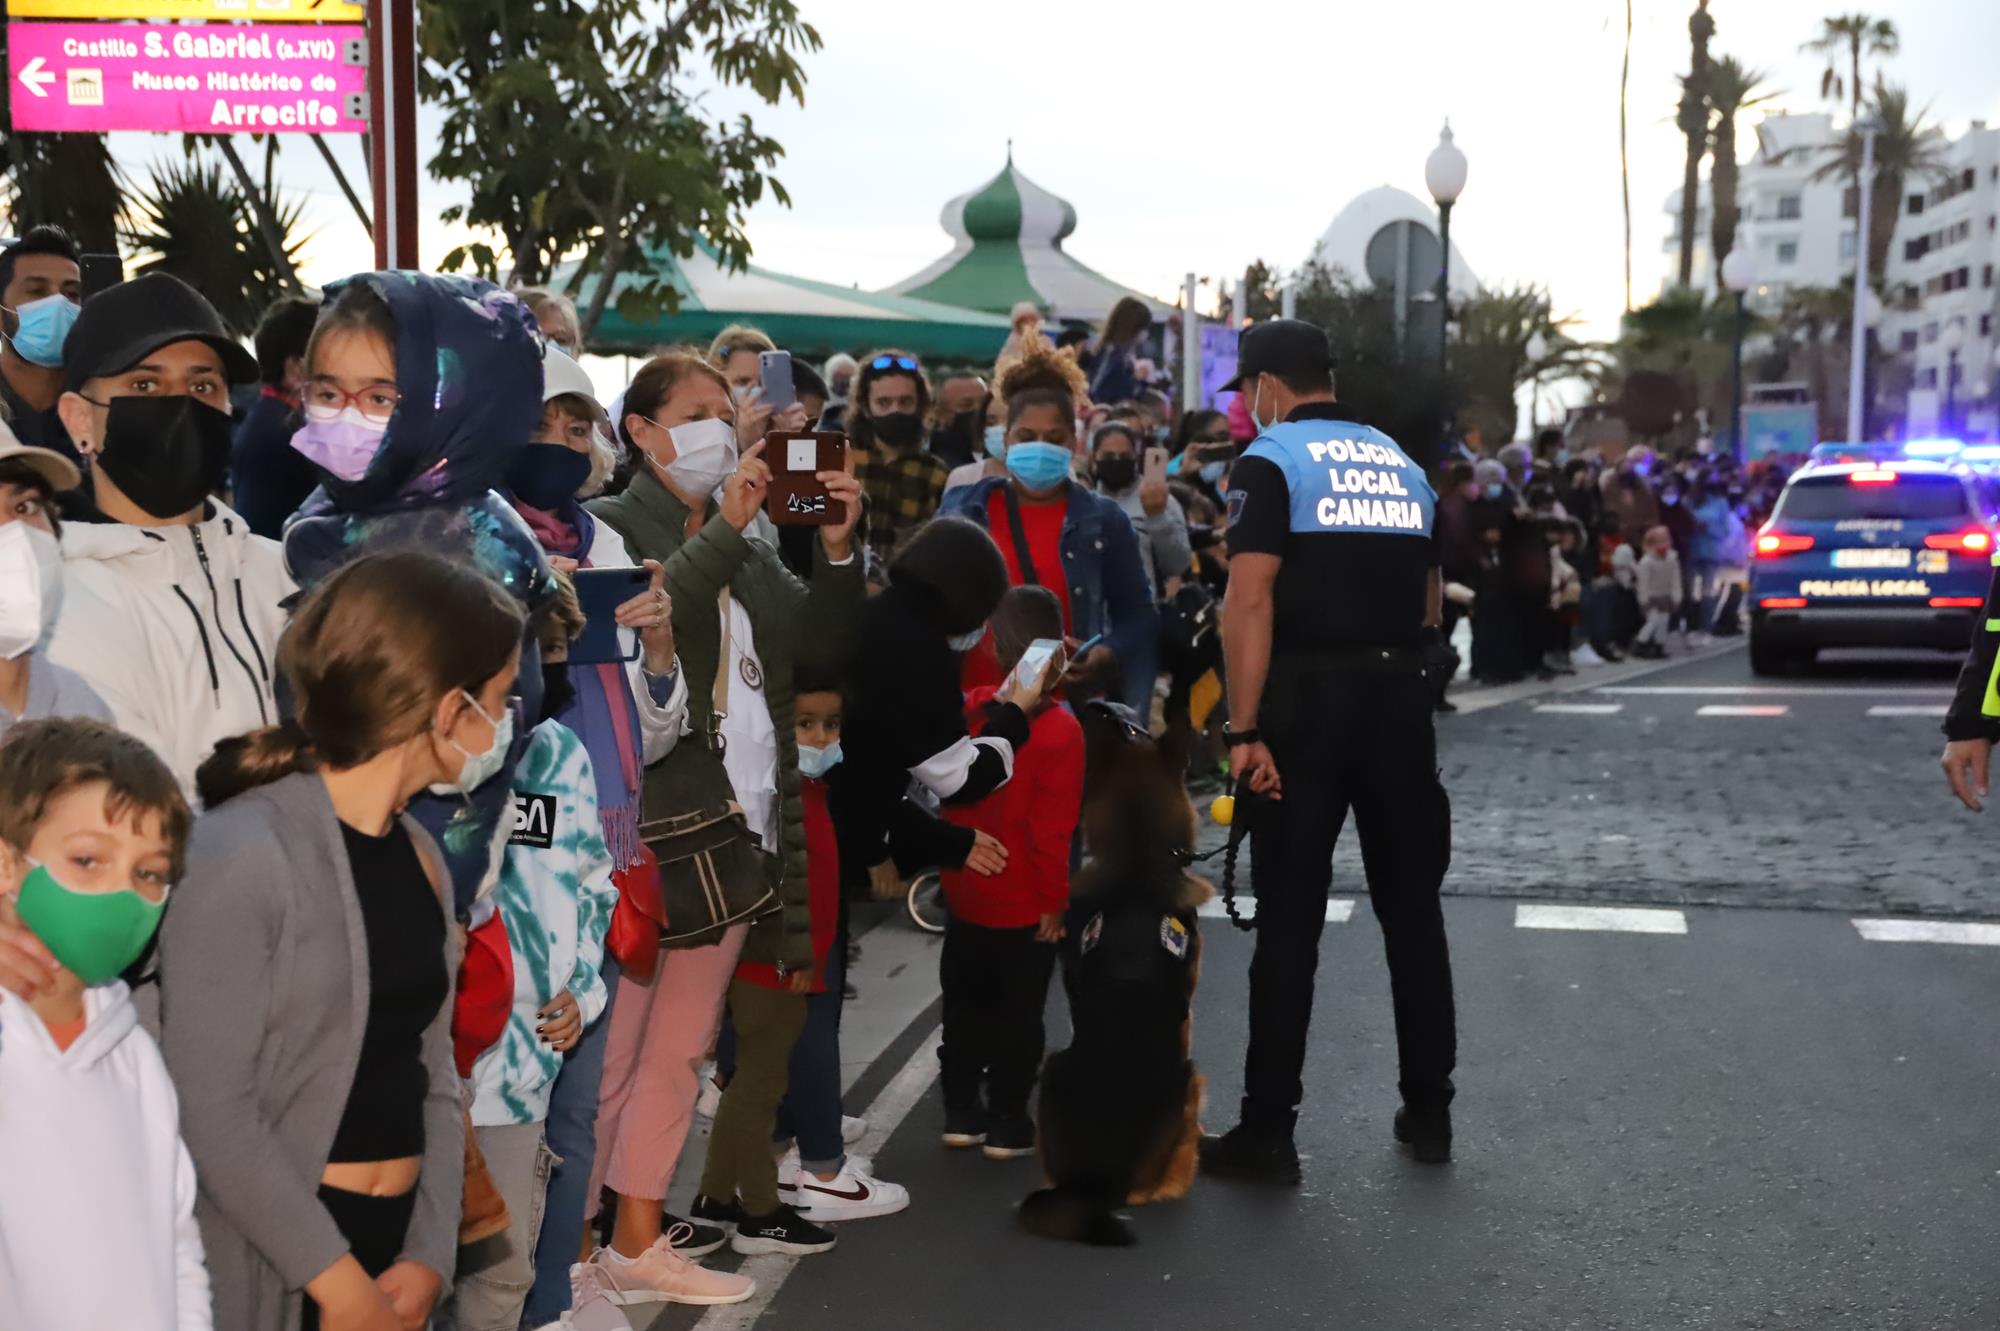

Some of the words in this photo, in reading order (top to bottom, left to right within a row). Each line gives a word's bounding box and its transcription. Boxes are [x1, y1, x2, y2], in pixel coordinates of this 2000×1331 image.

[64, 38, 137, 57] Castillo
[144, 31, 170, 58] S.
[173, 31, 272, 58] Gabriel
[133, 71, 199, 91] Museo
[207, 71, 303, 91] Histórico
[311, 73, 336, 91] de
[211, 98, 337, 126] Arrecife
[1306, 439, 1406, 468] POLICIA
[1329, 468, 1408, 496] LOCAL
[1317, 497, 1422, 529] CANARIA
[1871, 580, 1930, 596] LOCAL
